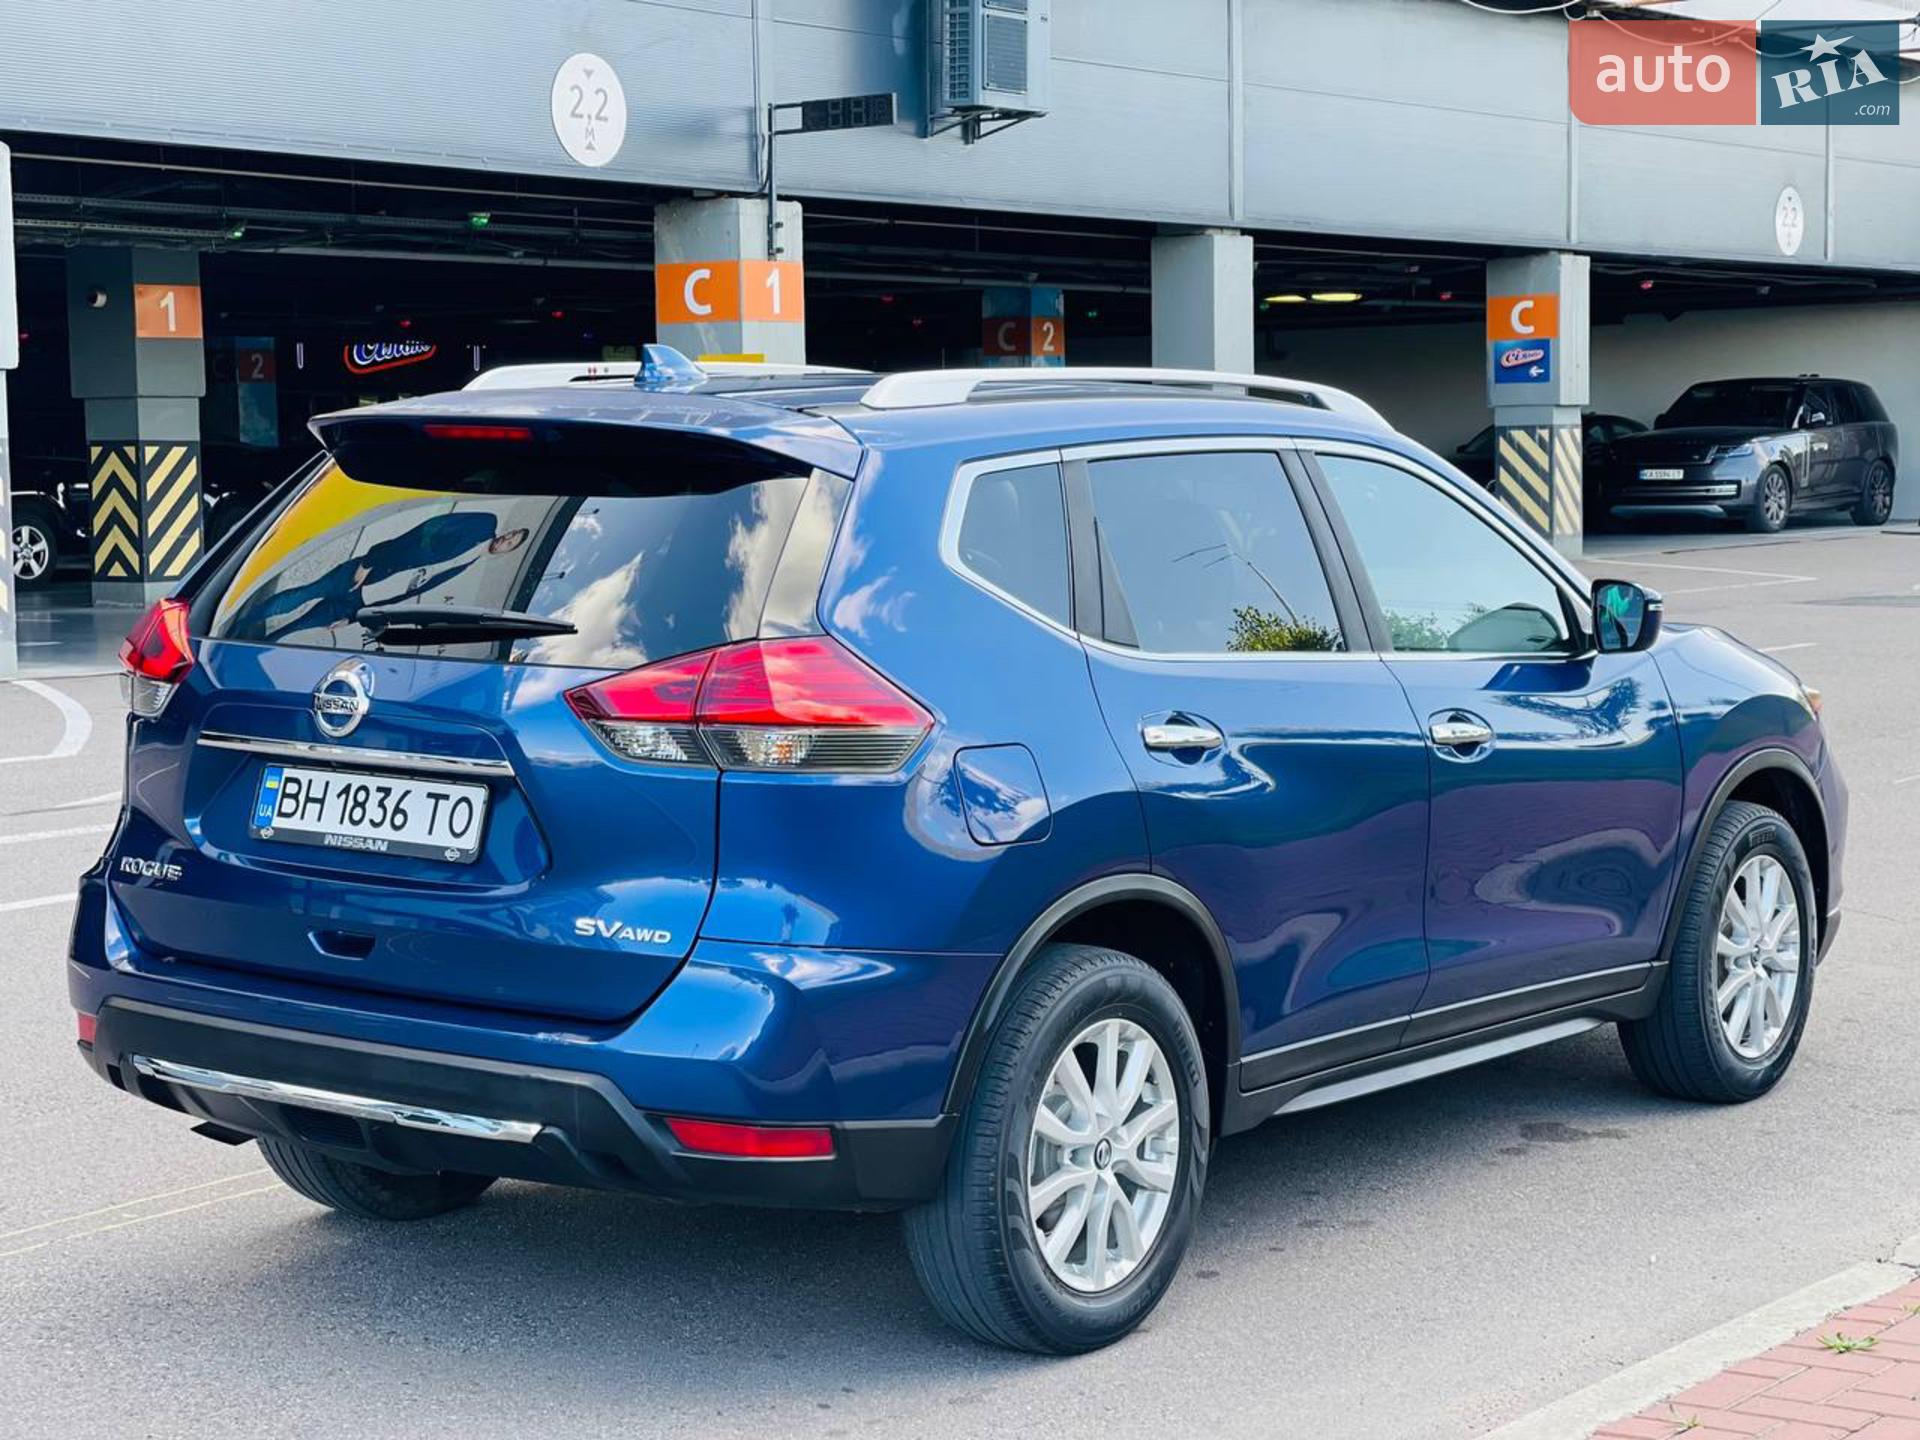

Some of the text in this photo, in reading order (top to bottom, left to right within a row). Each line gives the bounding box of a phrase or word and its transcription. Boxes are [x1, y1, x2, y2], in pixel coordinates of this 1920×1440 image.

[568, 84, 609, 125] 2,2
[683, 268, 781, 316] C 1
[159, 290, 177, 332] 1
[1510, 300, 1536, 334] C
[1043, 321, 1056, 352] 2
[251, 352, 265, 379] 2
[258, 804, 273, 818] UA
[276, 776, 474, 839] BH 1836 TO
[324, 833, 389, 852] NISSAN
[120, 856, 183, 881] ROGUE
[574, 917, 672, 943] SV AWD
